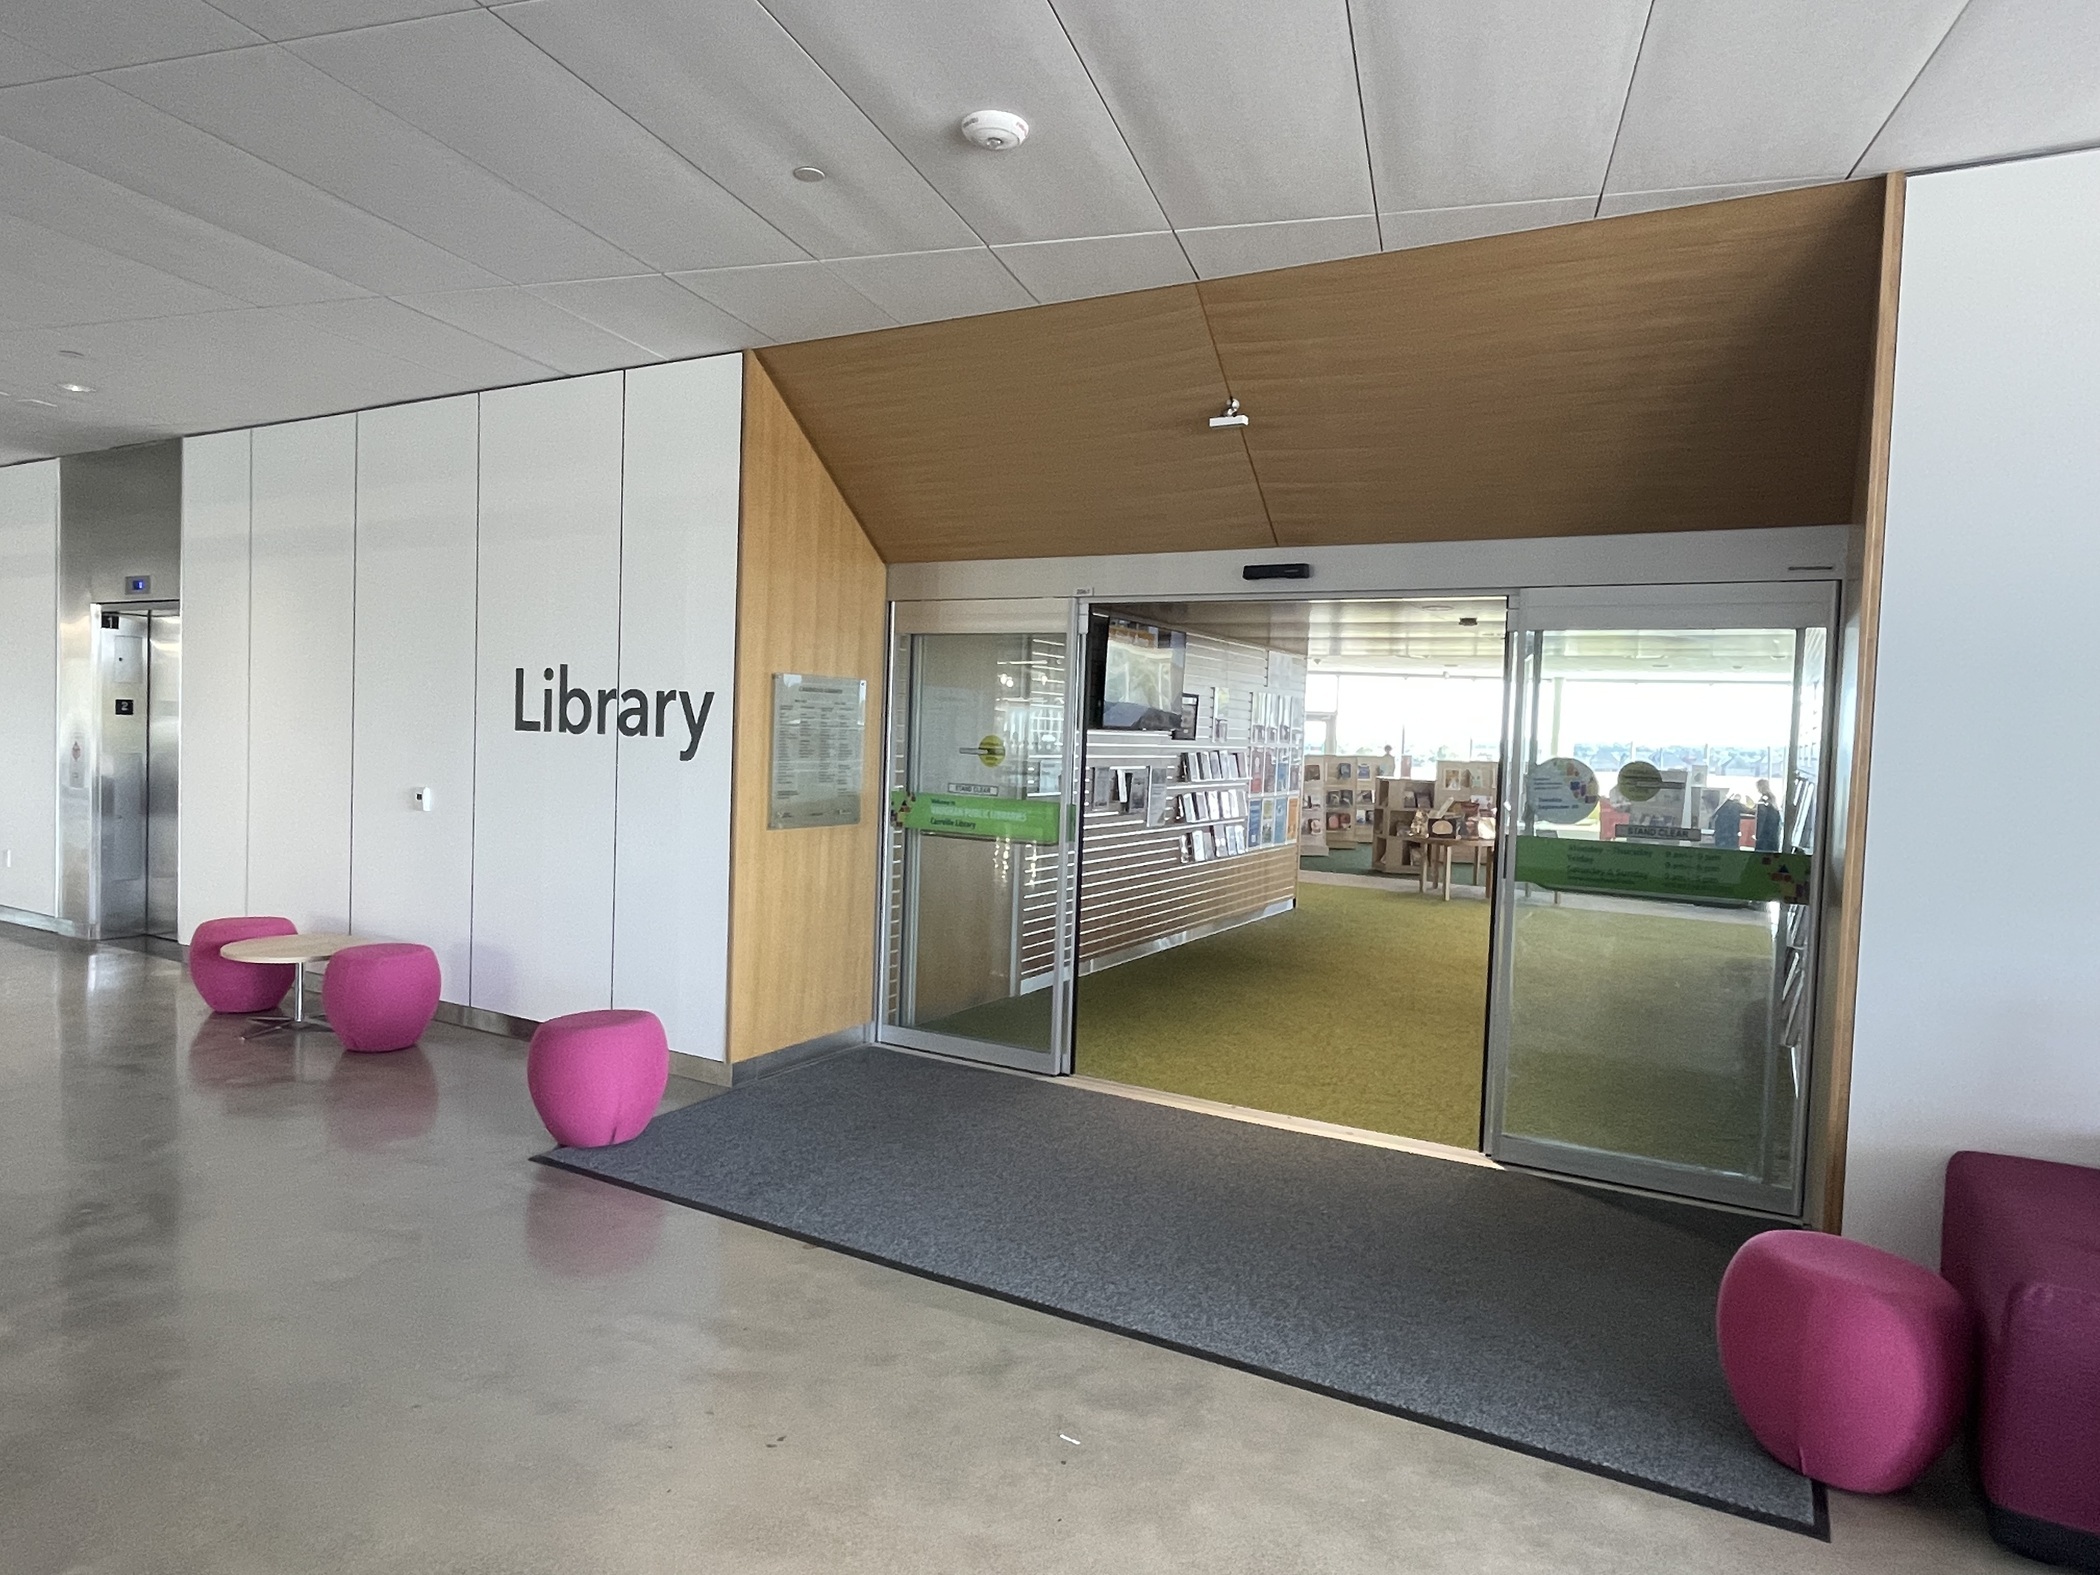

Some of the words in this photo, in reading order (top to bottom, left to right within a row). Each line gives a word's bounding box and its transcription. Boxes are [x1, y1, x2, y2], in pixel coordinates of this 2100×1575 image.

[121, 701, 129, 711] 2
[514, 663, 715, 762] Library
[1627, 826, 1656, 836] STAND
[1658, 828, 1689, 838] CLEAR
